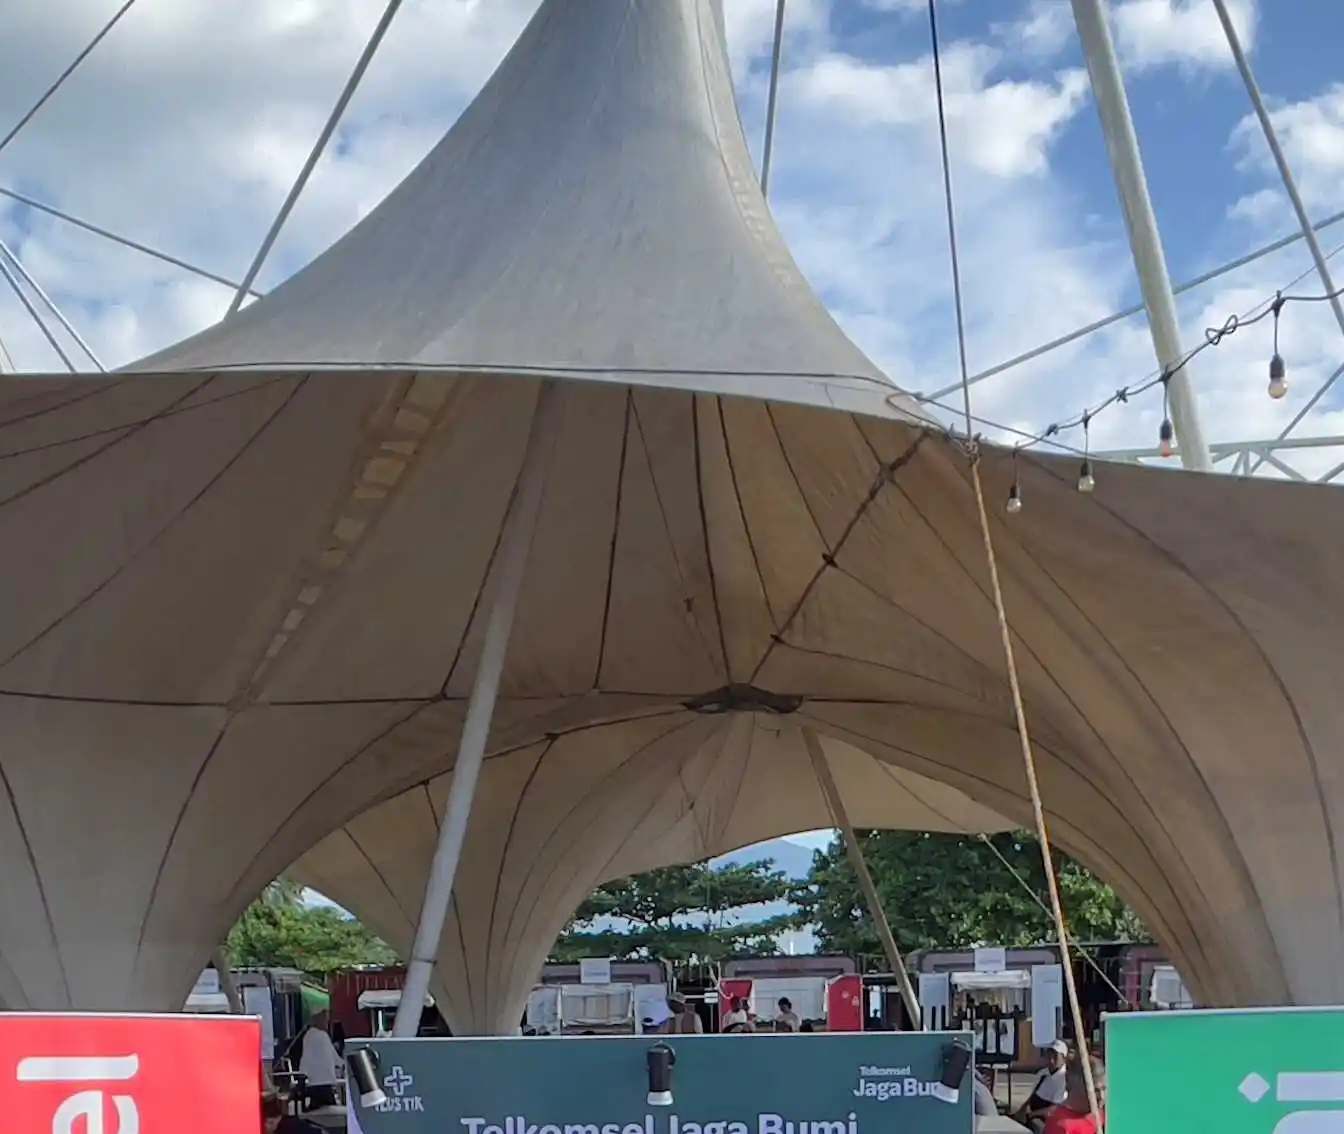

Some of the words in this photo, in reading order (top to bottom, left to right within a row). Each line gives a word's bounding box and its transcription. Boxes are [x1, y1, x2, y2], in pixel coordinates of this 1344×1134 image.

[859, 1065, 912, 1077] Telkomsel
[853, 1078, 902, 1102] Jaga
[903, 1077, 940, 1097] Bu
